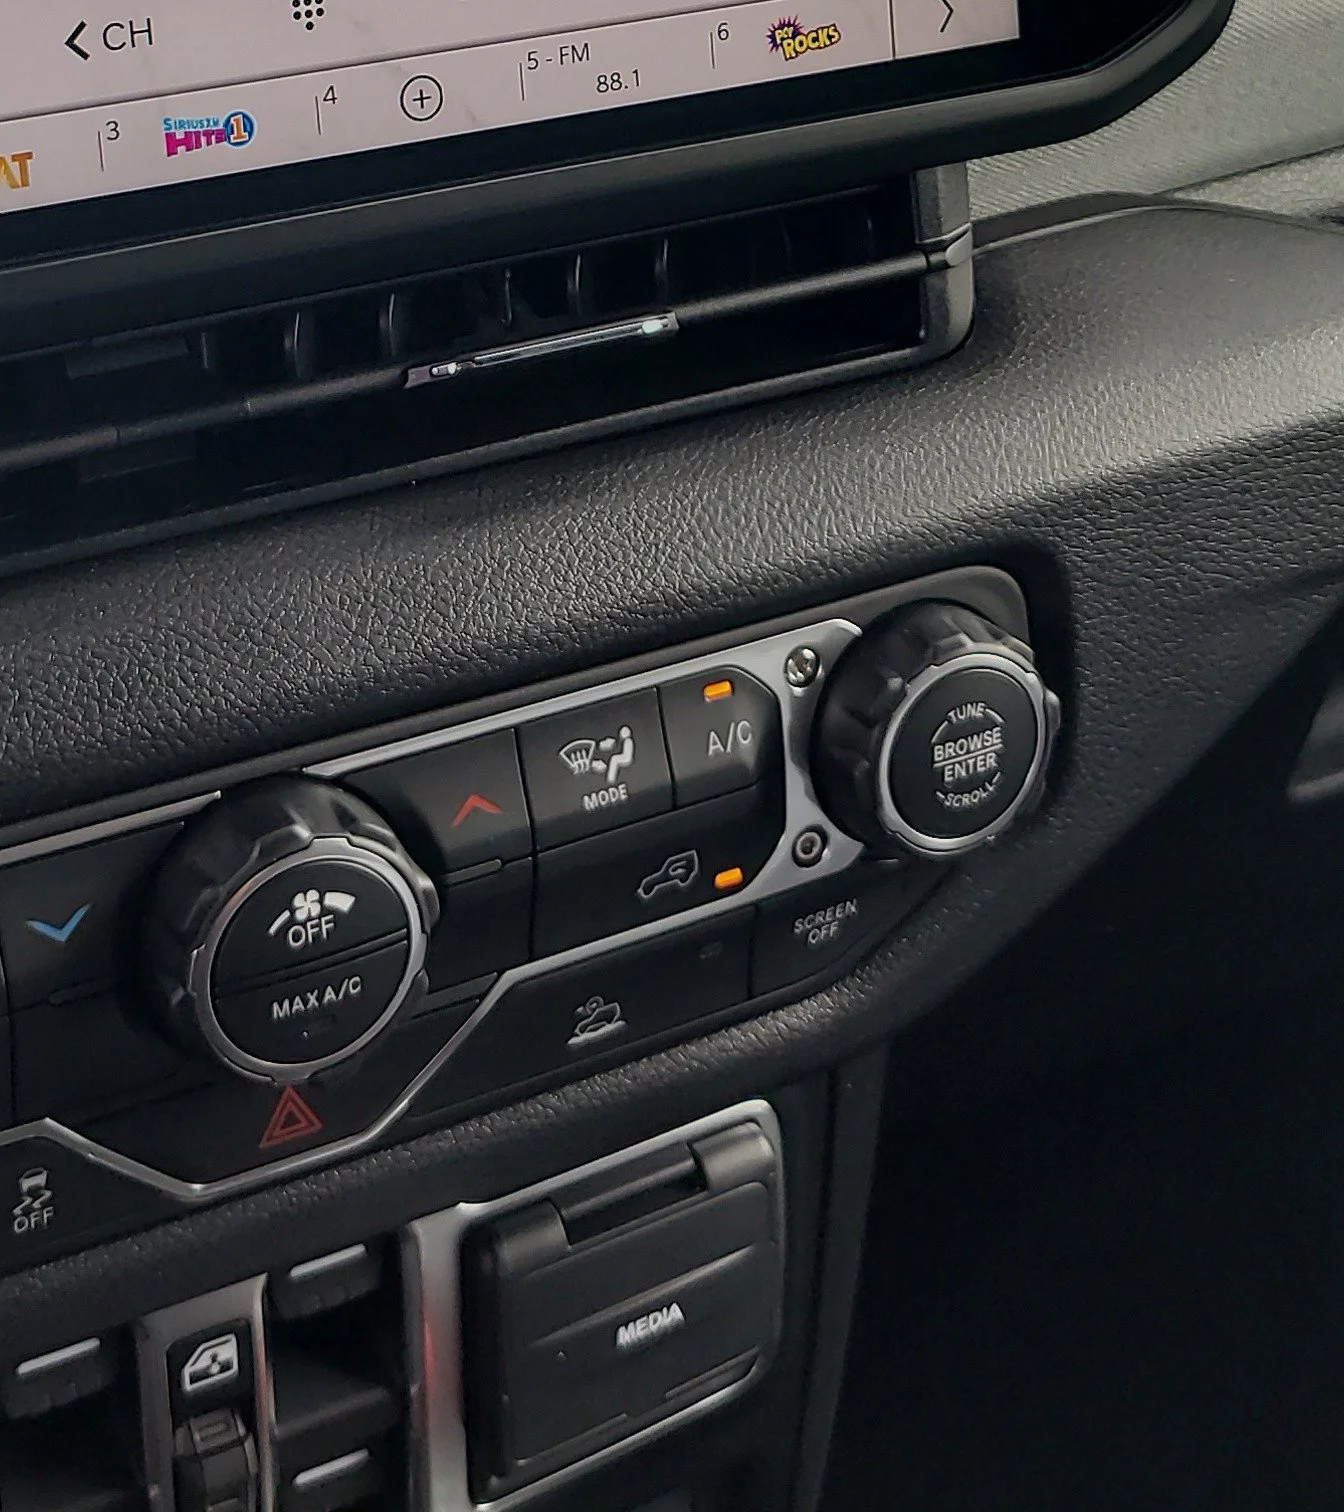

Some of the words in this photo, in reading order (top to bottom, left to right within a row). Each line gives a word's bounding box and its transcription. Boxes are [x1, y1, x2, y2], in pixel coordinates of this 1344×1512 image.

[102, 18, 154, 52] CH
[717, 22, 730, 41] 6
[782, 24, 841, 60] ROCKS
[527, 50, 539, 70] 5
[559, 43, 590, 64] FM
[322, 85, 338, 106] 4
[596, 70, 641, 93] 88.1
[106, 121, 120, 141] 3
[165, 128, 227, 157] HITS
[947, 702, 987, 725] TUNE
[707, 720, 752, 756] A/C
[933, 726, 1003, 763] BROWSE
[943, 752, 999, 782] ENTER
[583, 783, 628, 810] MODE
[944, 781, 997, 808] SCROLL
[793, 899, 857, 935] SCREEN
[288, 918, 336, 947] OFF
[806, 919, 840, 946] OFF
[272, 989, 319, 1020] MAX
[320, 975, 363, 1008] A/C
[12, 1206, 56, 1234] OFF
[615, 1301, 685, 1347] MEDIA
